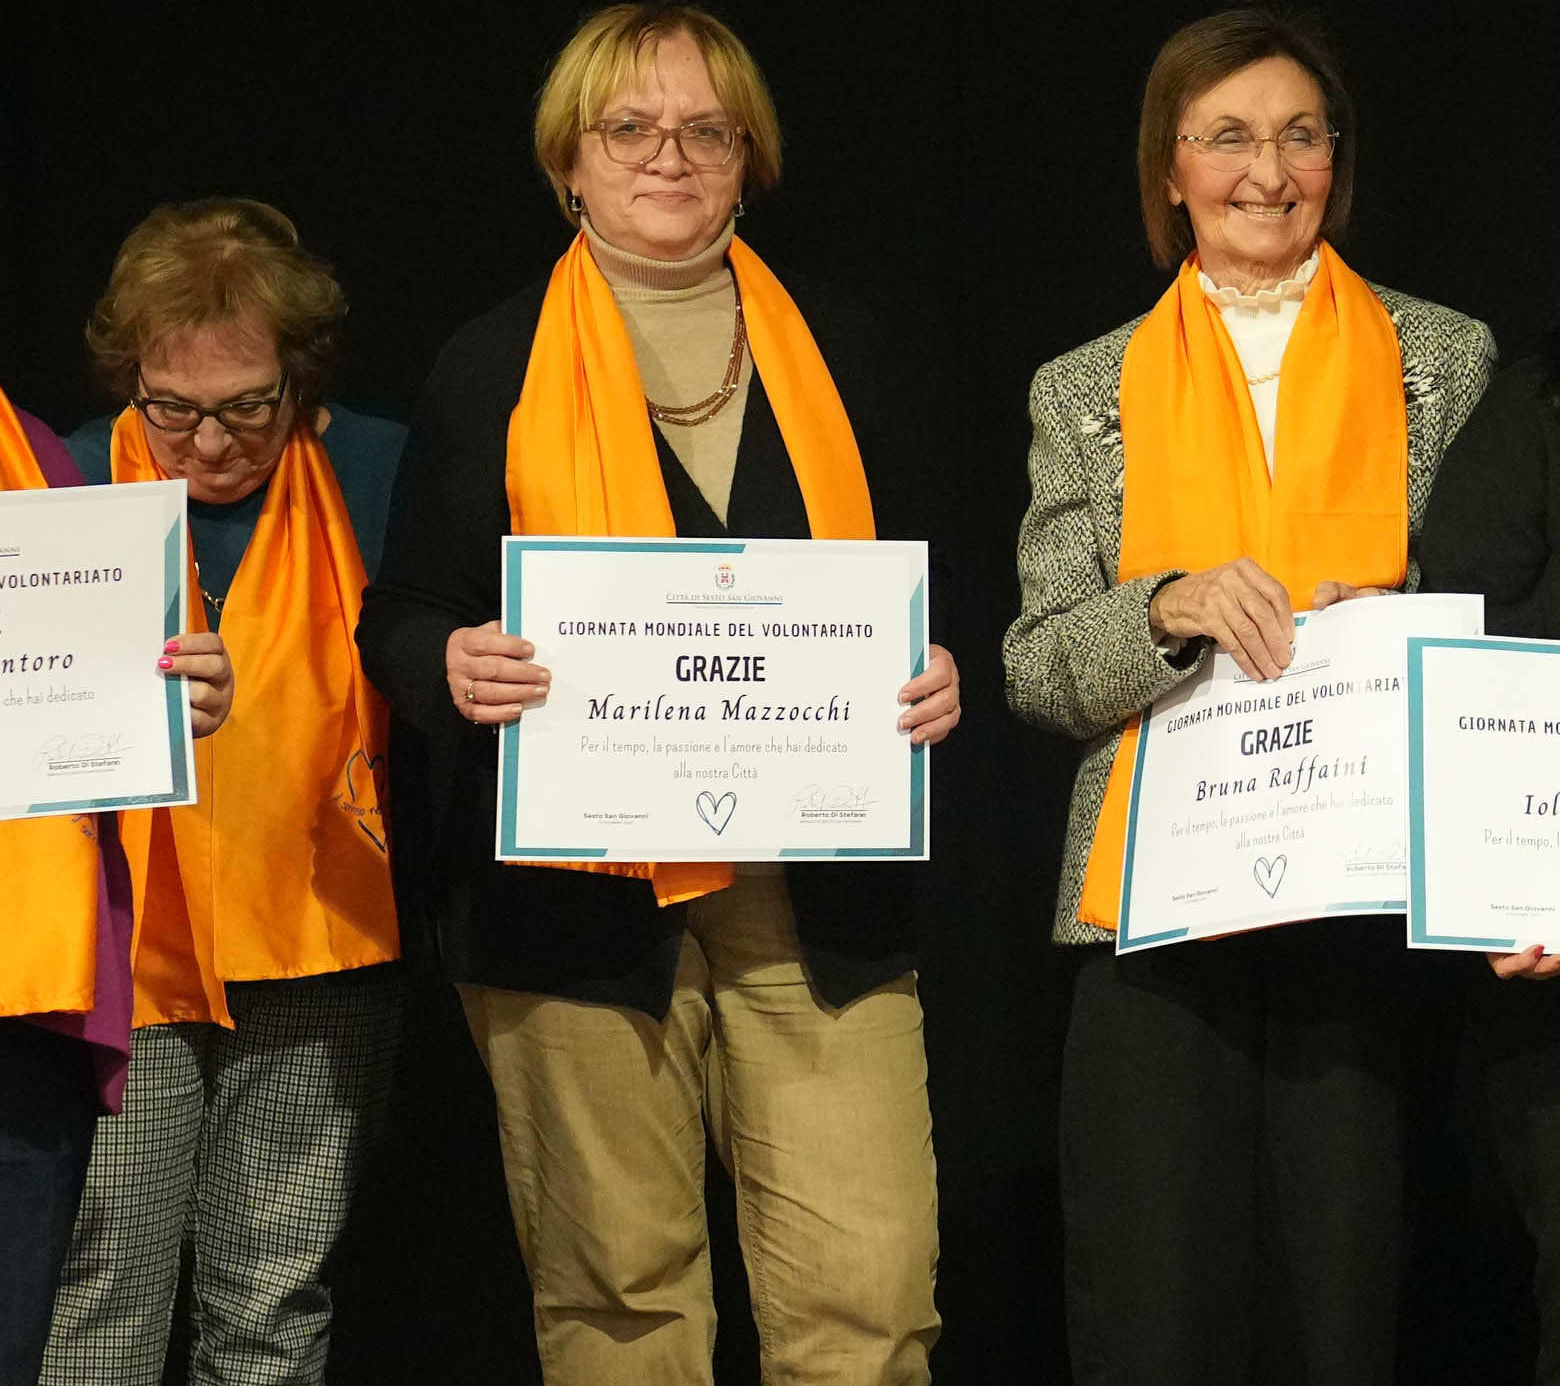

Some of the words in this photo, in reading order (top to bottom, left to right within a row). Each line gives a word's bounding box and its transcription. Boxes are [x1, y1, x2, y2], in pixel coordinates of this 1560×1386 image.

[558, 621, 637, 635] GIORNATA
[645, 622, 721, 636] MONDIALE
[729, 623, 755, 636] DEL
[763, 623, 873, 637] VOLONTARIATO
[676, 655, 766, 681] GRAZIE
[4, 688, 23, 706] che
[27, 687, 44, 704] hai
[47, 684, 95, 703] dedicato
[1168, 707, 1212, 733] GIORNATA
[1217, 695, 1281, 716] MONDIALE
[1287, 691, 1306, 706] DEL
[1313, 677, 1405, 699] VOLONARIA
[588, 693, 707, 720] Marilena
[722, 694, 851, 720] Mazzocchi
[1459, 716, 1536, 733] GIORNATA
[581, 735, 599, 752] Per
[602, 734, 609, 751] il
[613, 741, 649, 756] tempo,
[654, 735, 662, 752] la
[666, 741, 711, 756] passione
[724, 734, 761, 752] l'amore
[765, 735, 783, 753] che
[786, 735, 801, 752] hai
[804, 735, 848, 752] dedicato
[1241, 719, 1314, 755] GRAZIE
[673, 761, 692, 778] alla
[696, 768, 729, 778] nostra
[731, 762, 758, 778] Città
[1197, 778, 1257, 801] Bruna
[1269, 755, 1367, 794] Raffaini
[1484, 828, 1503, 844] Per
[1506, 828, 1513, 845] il
[1516, 836, 1553, 850] tempo,
